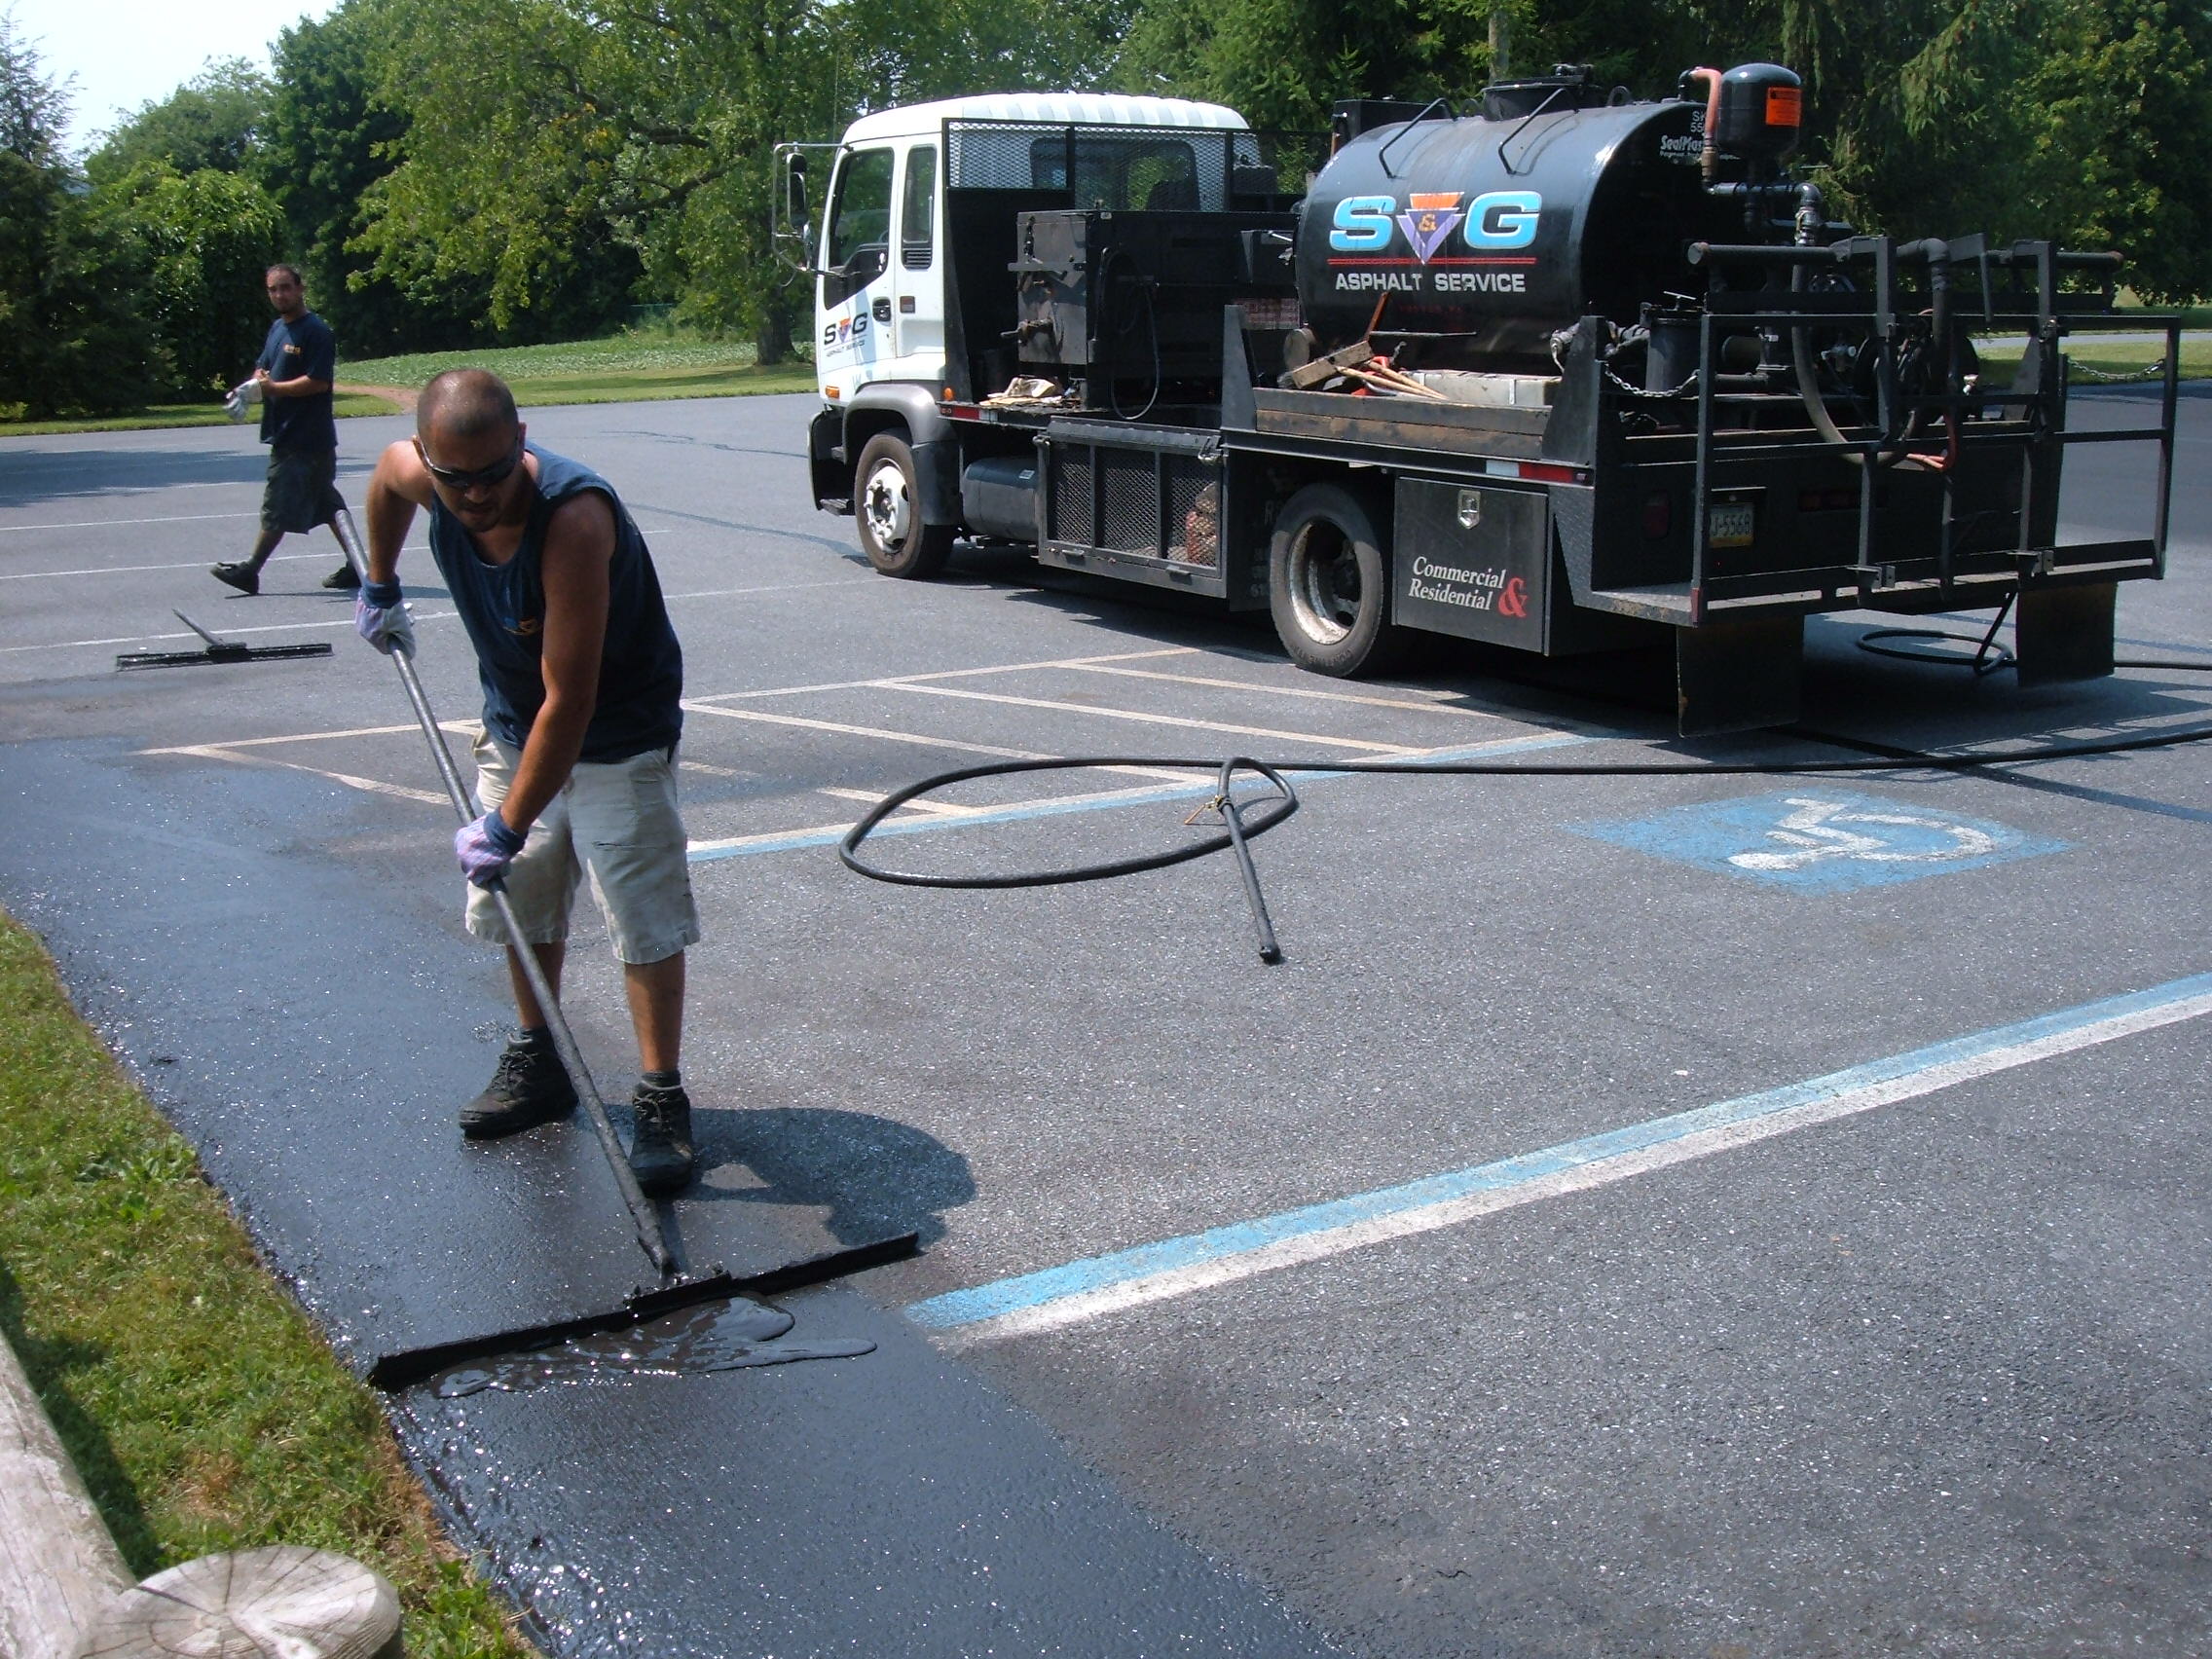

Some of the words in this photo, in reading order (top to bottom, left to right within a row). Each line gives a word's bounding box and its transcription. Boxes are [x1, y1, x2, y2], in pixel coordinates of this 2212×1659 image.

[1690, 122, 1704, 132] 55
[1660, 134, 1704, 151] SealMas
[1335, 273, 1422, 292] ASPHALT
[1435, 273, 1526, 293] SERVICE
[1413, 555, 1507, 589] Commercial
[1408, 577, 1494, 611] Residential
[1497, 576, 1529, 618] &
